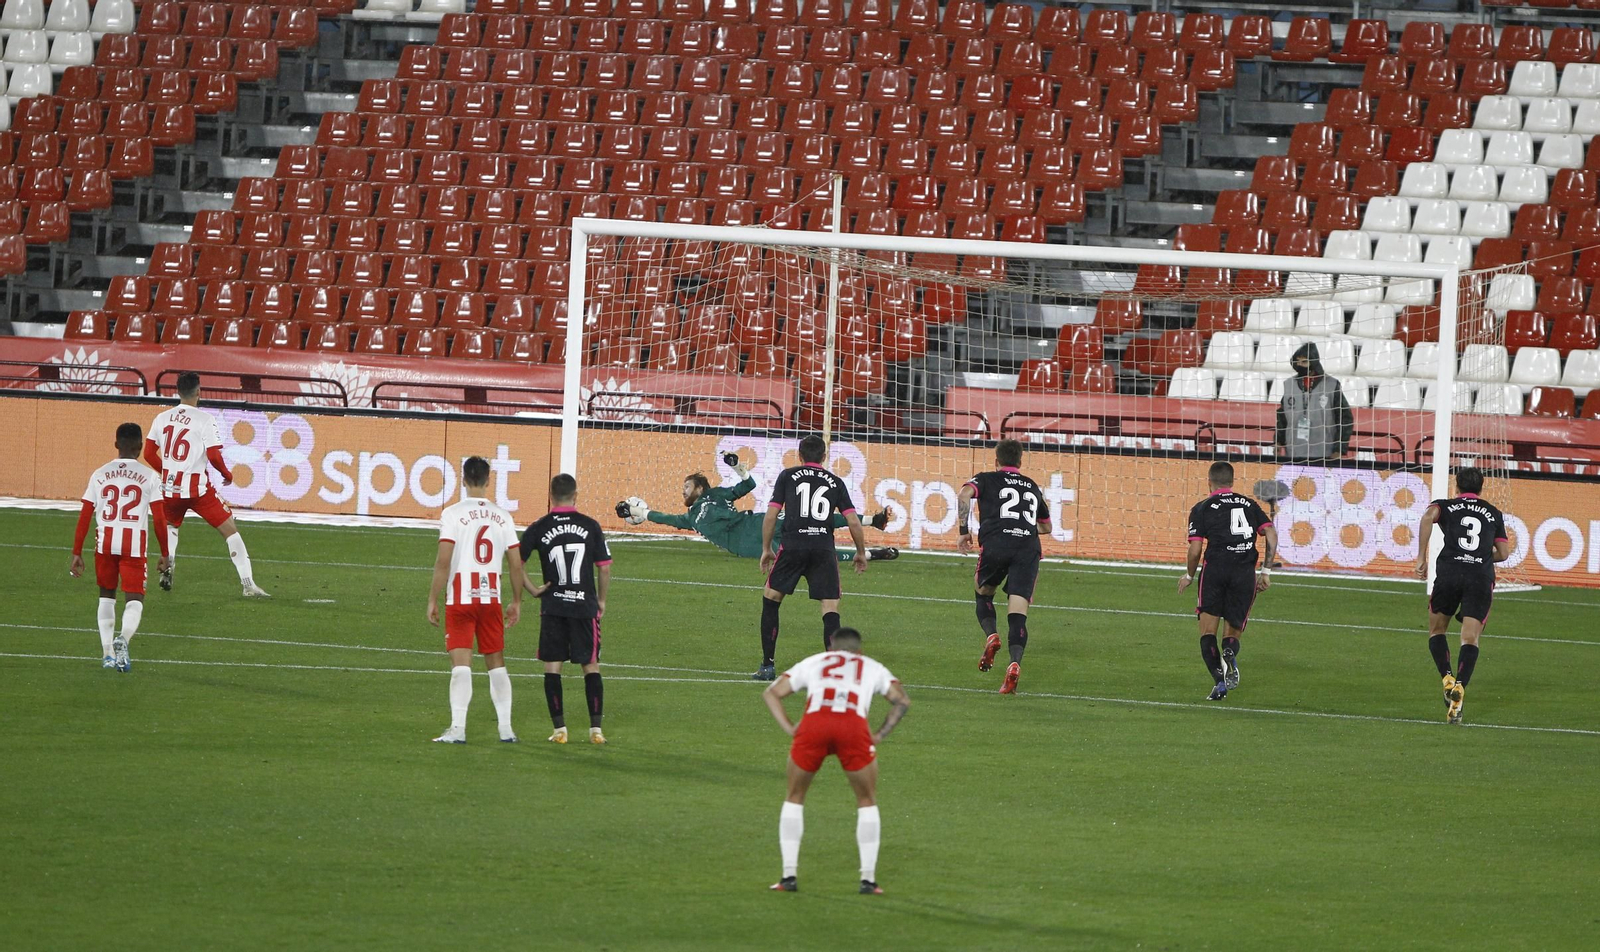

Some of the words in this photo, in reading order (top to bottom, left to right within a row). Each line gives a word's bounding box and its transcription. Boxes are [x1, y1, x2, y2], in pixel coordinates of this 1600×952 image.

[169, 413, 192, 426] LAZO
[162, 424, 191, 462] 16
[105, 468, 148, 485] RAMAZANI
[791, 468, 815, 481] AITOR
[817, 471, 837, 489] SANZ
[101, 484, 143, 522] 32
[795, 482, 831, 521] 16
[998, 487, 1039, 526] 23
[1210, 502, 1221, 510] B.
[1466, 503, 1495, 523] MUÑOZ
[459, 517, 470, 526] C.
[468, 510, 479, 520] DE
[479, 509, 490, 519] LA
[490, 513, 506, 528] HOZ
[541, 523, 590, 545] SHASHOUA
[1229, 507, 1254, 540] 4
[1457, 515, 1482, 552] 3
[473, 524, 494, 565] 6
[548, 542, 586, 586] 17
[821, 655, 865, 685] 21
